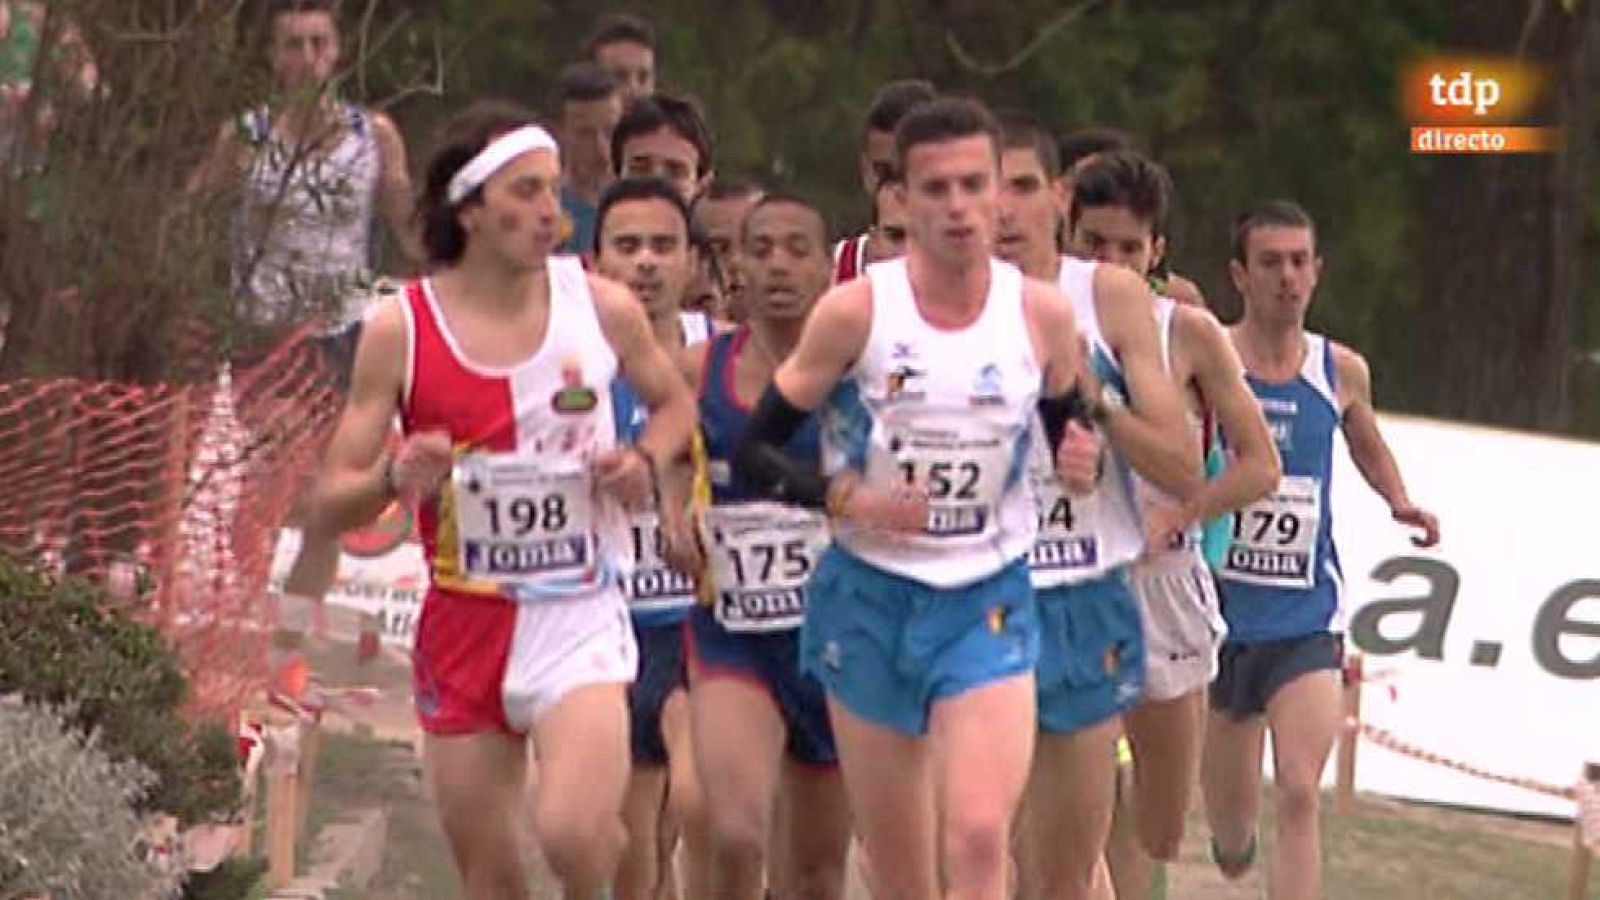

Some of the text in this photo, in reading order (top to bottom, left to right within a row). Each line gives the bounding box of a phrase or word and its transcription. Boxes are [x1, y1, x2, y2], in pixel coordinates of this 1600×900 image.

[899, 461, 980, 499] 152
[484, 493, 567, 537] 198
[1233, 508, 1299, 545] 179
[730, 540, 809, 585] 175
[1230, 550, 1302, 574] oma
